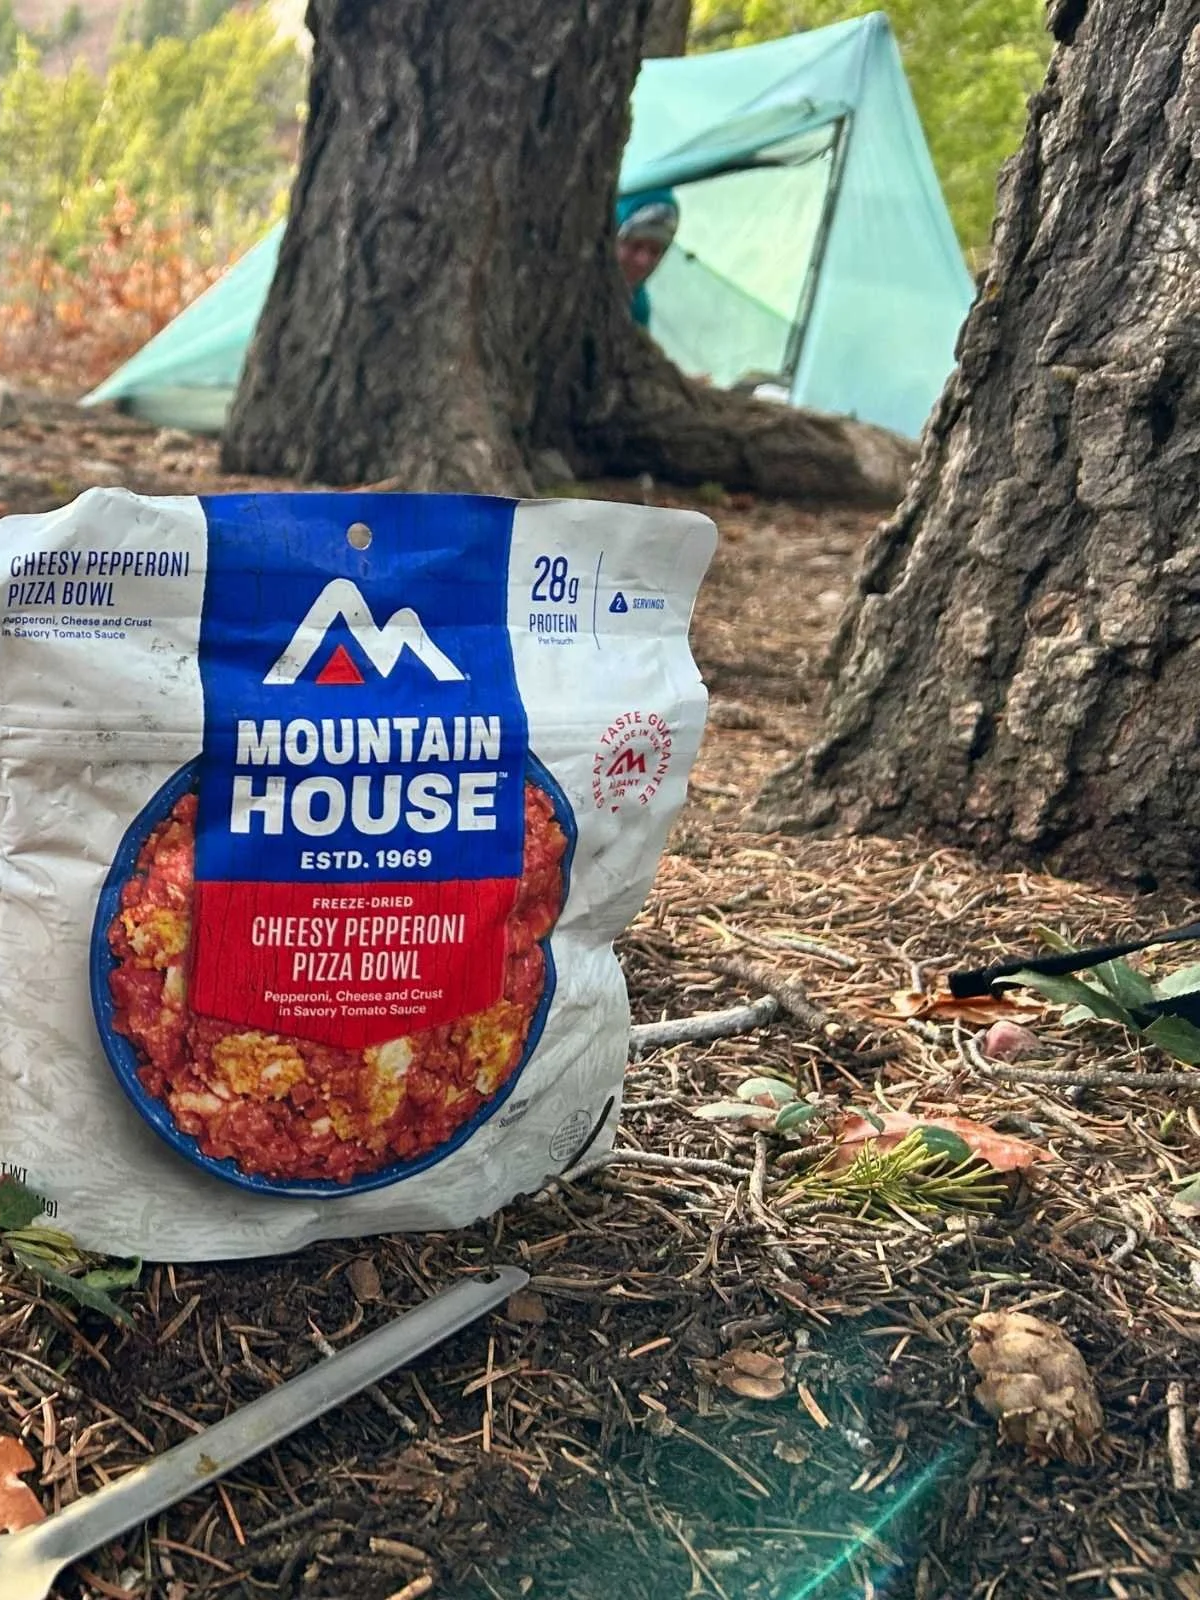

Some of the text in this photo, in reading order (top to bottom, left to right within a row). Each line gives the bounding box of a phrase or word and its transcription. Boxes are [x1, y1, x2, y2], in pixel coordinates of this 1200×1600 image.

[10, 551, 189, 577] CHEESY PEPPERONI
[531, 555, 579, 604] 28g
[7, 581, 115, 607] PIZZA BOWL
[632, 599, 665, 609] SERVINGS
[61, 615, 99, 626] Cheese
[103, 616, 121, 626] and
[124, 617, 152, 627] Crust
[529, 614, 577, 633] PROTEIN
[2, 628, 126, 639] in Savory Tomato Sauce
[236, 715, 501, 766] MOUNTAIN
[601, 711, 642, 745] TASTE
[638, 713, 672, 805] GUARANTEE
[230, 771, 498, 837] HOUSE
[300, 848, 432, 870] ESTD. 1969
[312, 896, 414, 909] FREEZE-DRIED
[251, 914, 465, 947] CHEESY PEPPERONI
[292, 951, 421, 982] PIZZA BOWL
[264, 988, 443, 1004] Pepperoni, Cheese and Crust
[279, 1003, 427, 1018] in Savory Tomato Sauce
